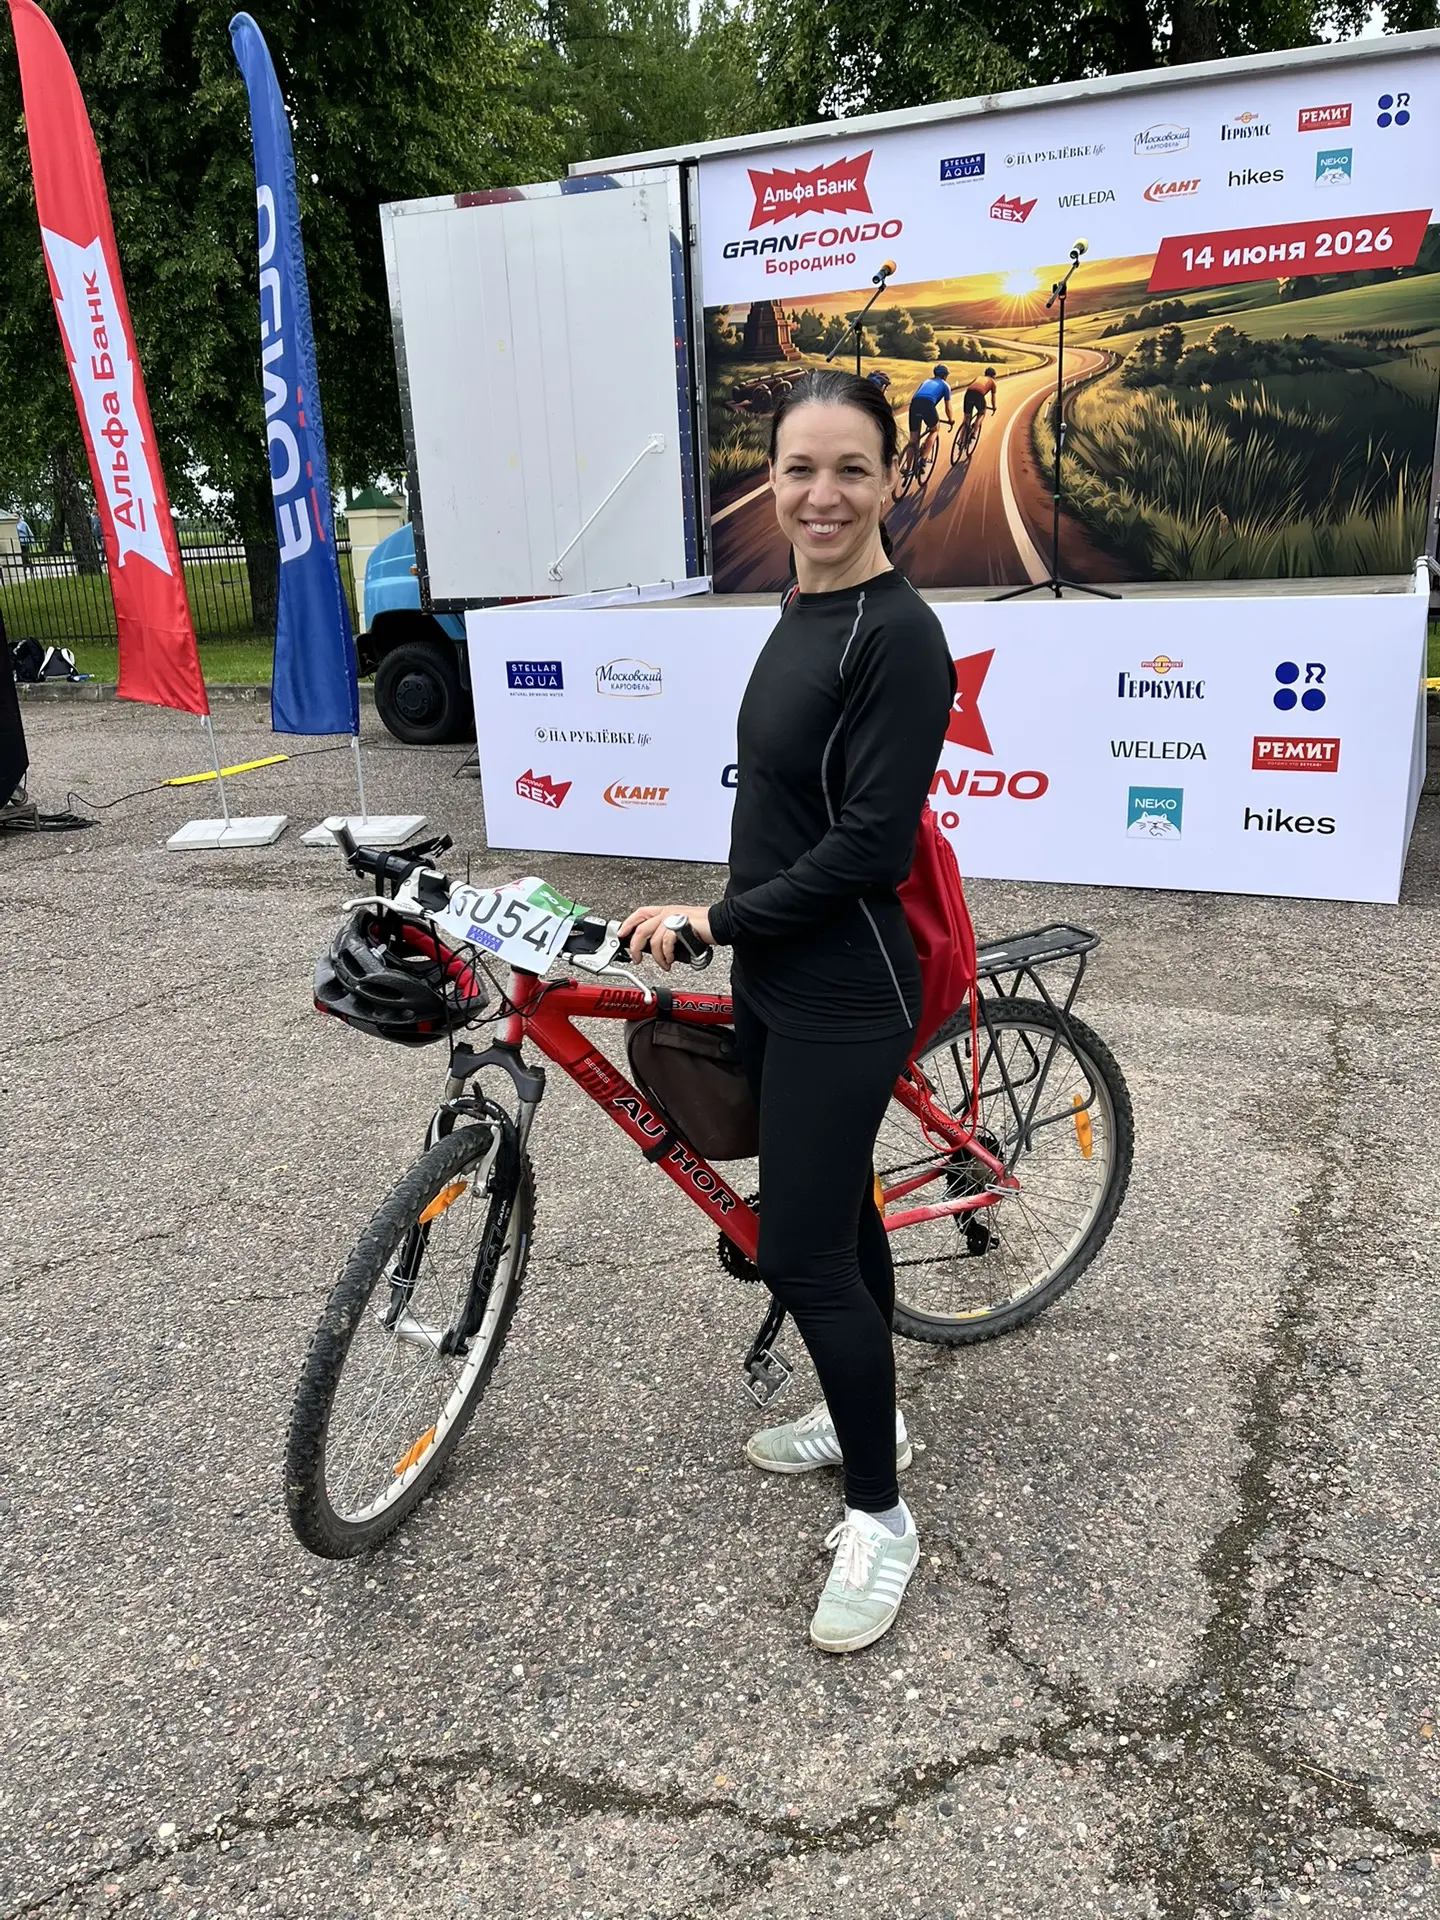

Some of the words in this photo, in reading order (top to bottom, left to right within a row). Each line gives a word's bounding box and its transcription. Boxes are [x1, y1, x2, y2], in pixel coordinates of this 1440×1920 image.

[1301, 107, 1349, 123] РЕМИТ
[1135, 130, 1190, 146] Московский
[944, 156, 981, 167] STELLAR
[1035, 145, 1091, 162] РУБЛЁВКЕ
[1320, 156, 1348, 166] NEKO
[945, 165, 981, 178] AQUA
[1228, 168, 1284, 187] hikes
[763, 182, 814, 205] Альфа
[817, 177, 857, 197] Банк
[1153, 179, 1201, 195] КАНТ
[1058, 189, 1115, 208] WELEDA
[991, 208, 1024, 222] REX
[723, 219, 903, 259] GRANFONDO
[1181, 245, 1215, 271] 14
[1222, 241, 1306, 267] июня
[1314, 226, 1393, 258] 2026
[765, 252, 857, 275] Бородино
[82, 269, 115, 380] Банк
[101, 391, 136, 530] Альфа
[511, 664, 557, 672] STELLAR
[597, 665, 662, 681] Московский
[514, 675, 558, 686] AQUA
[1118, 672, 1205, 699] ГЕРКУЛЕС
[569, 729, 635, 744] РУБЛЁВКЕ
[637, 733, 652, 746] life
[1110, 740, 1207, 760] WELEDA
[1258, 741, 1335, 759] РЕМИТ
[520, 777, 545, 788] protein
[518, 782, 557, 807] REX
[614, 785, 670, 801] КАНТ
[1134, 797, 1177, 810] NEKO
[1244, 807, 1336, 835] hikes
[469, 933, 497, 949] AQUA
[472, 926, 501, 943] STELLAR
[672, 998, 733, 1014] BASIC
[583, 1057, 611, 1084] SERIES
[612, 1097, 736, 1215] AUHOR
